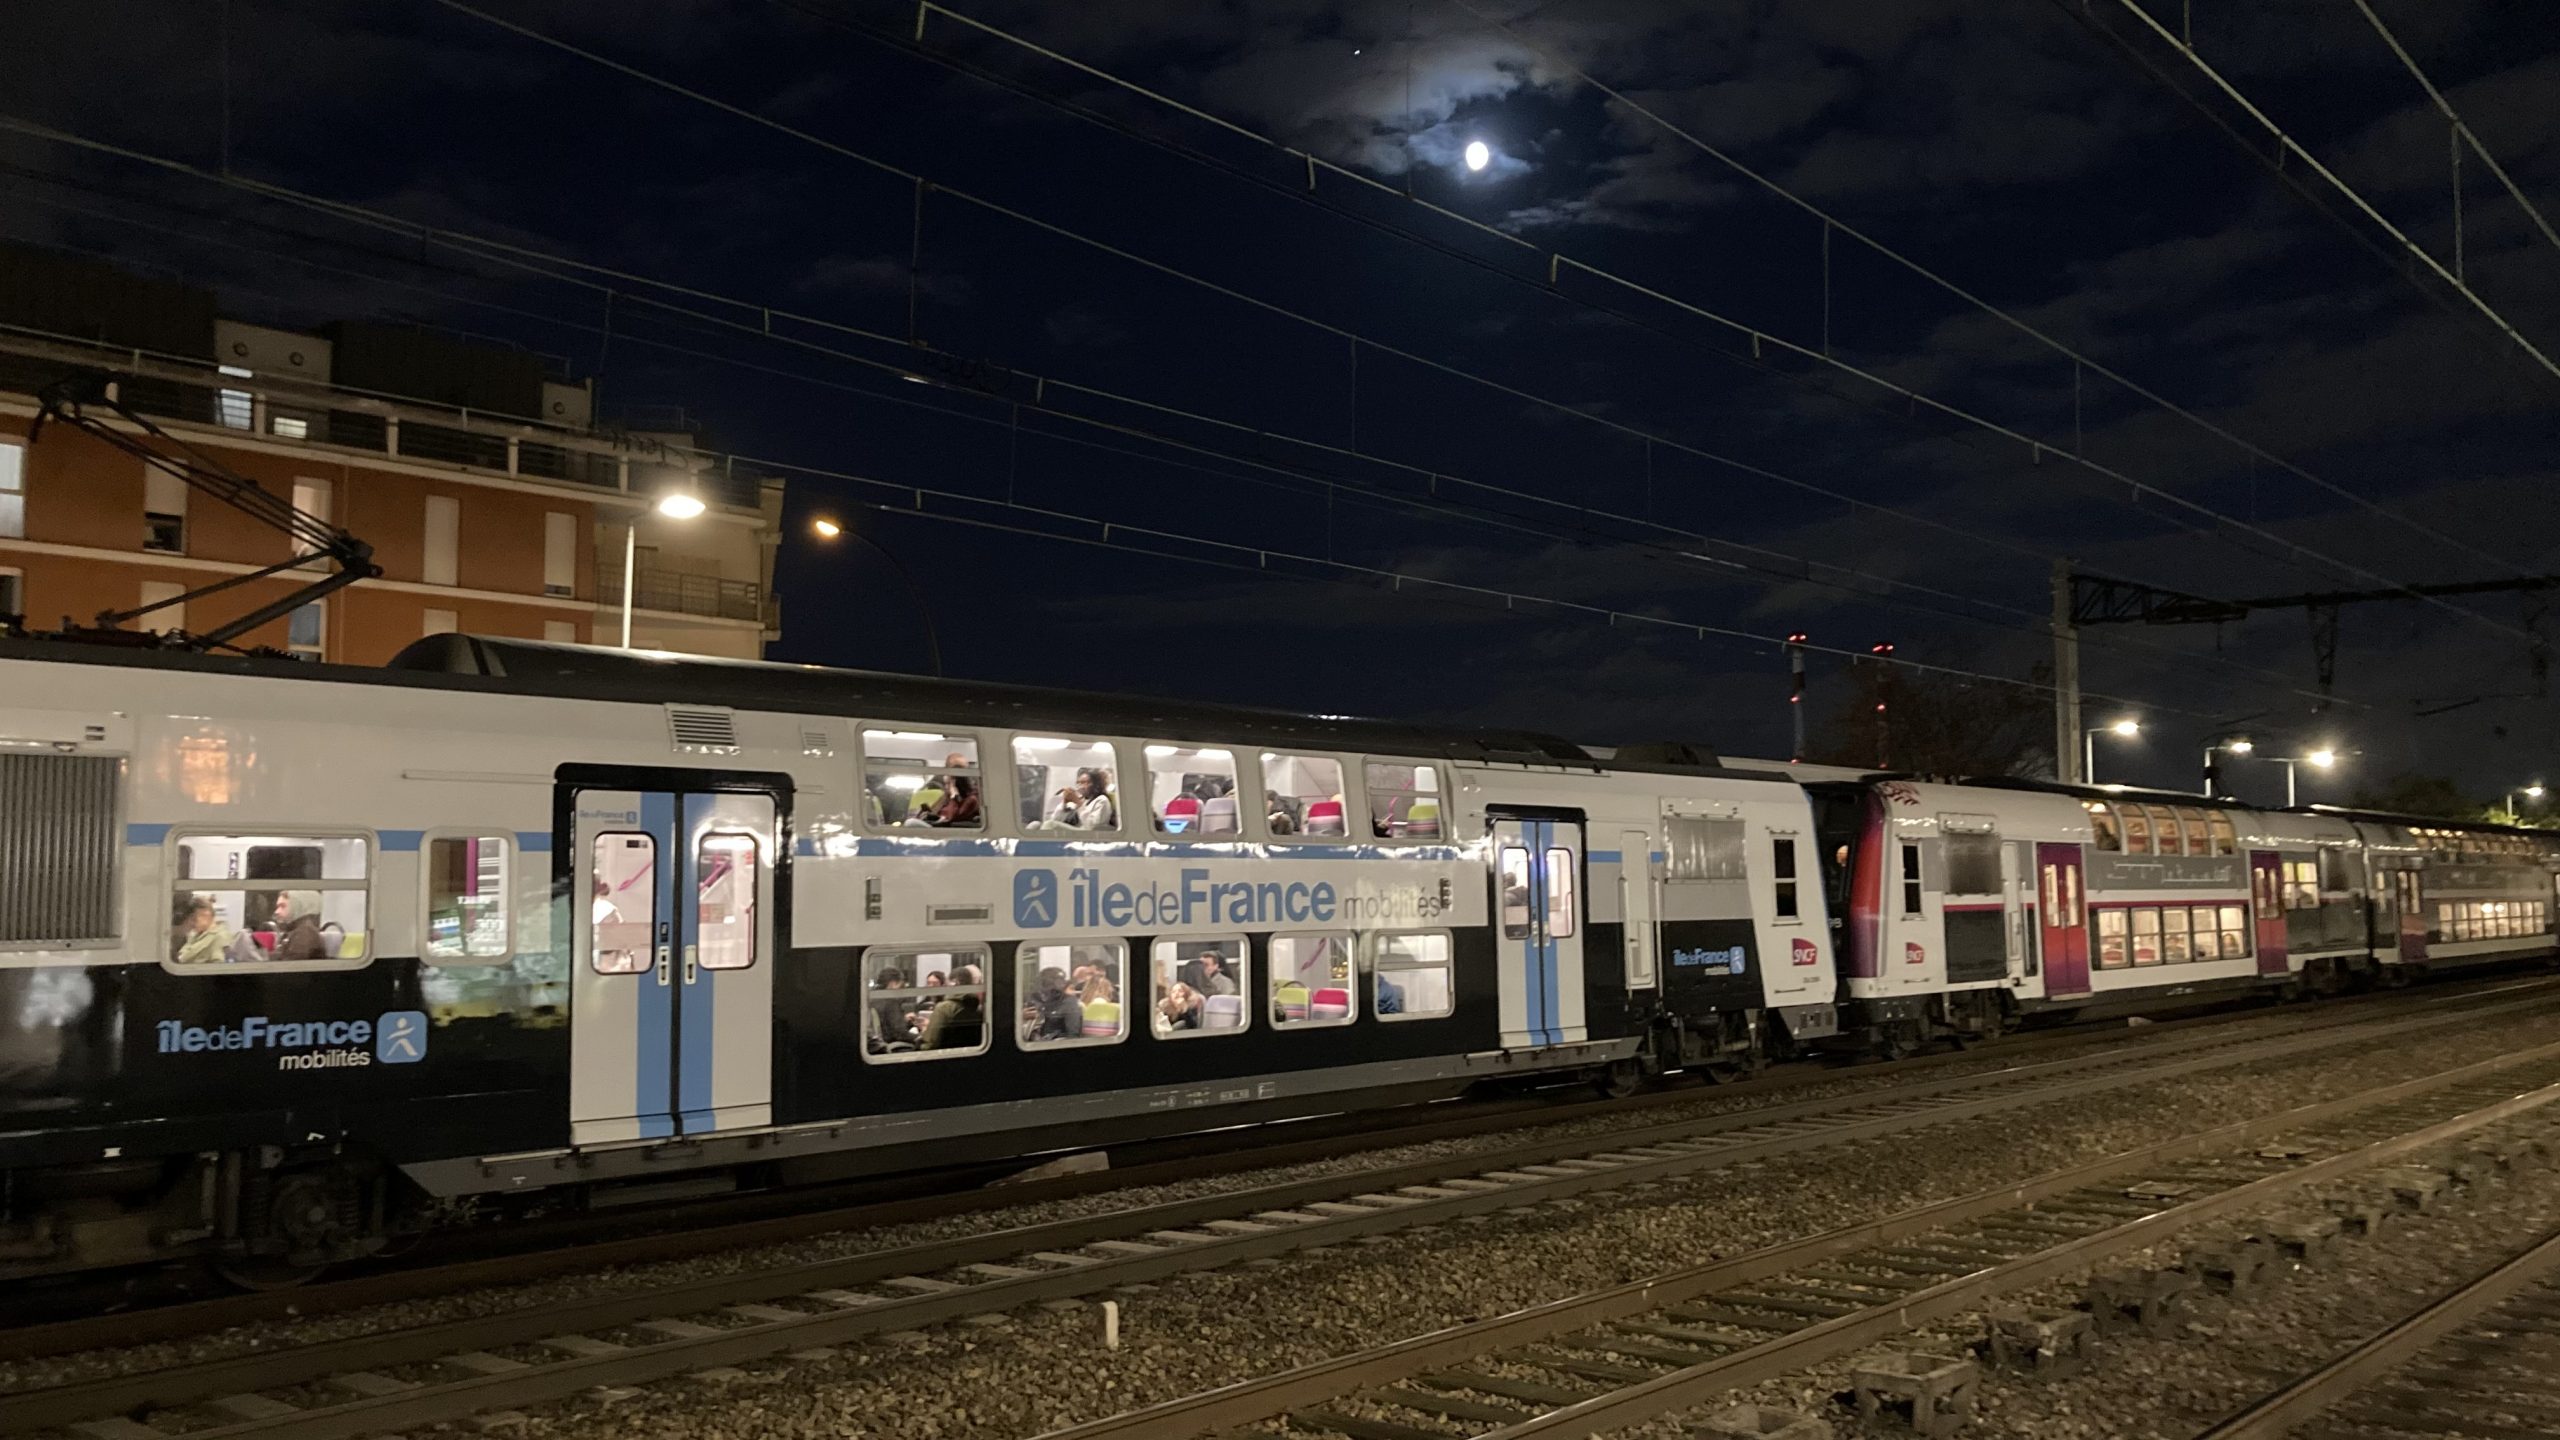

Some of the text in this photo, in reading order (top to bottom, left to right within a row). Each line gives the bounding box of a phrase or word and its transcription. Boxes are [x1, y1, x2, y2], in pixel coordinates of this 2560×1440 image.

[1068, 868, 1442, 928] îledeFrance mobilités
[1793, 948, 1816, 964] SNCF
[155, 1016, 372, 1053] îledeFrance
[279, 1046, 372, 1071] mobilités
